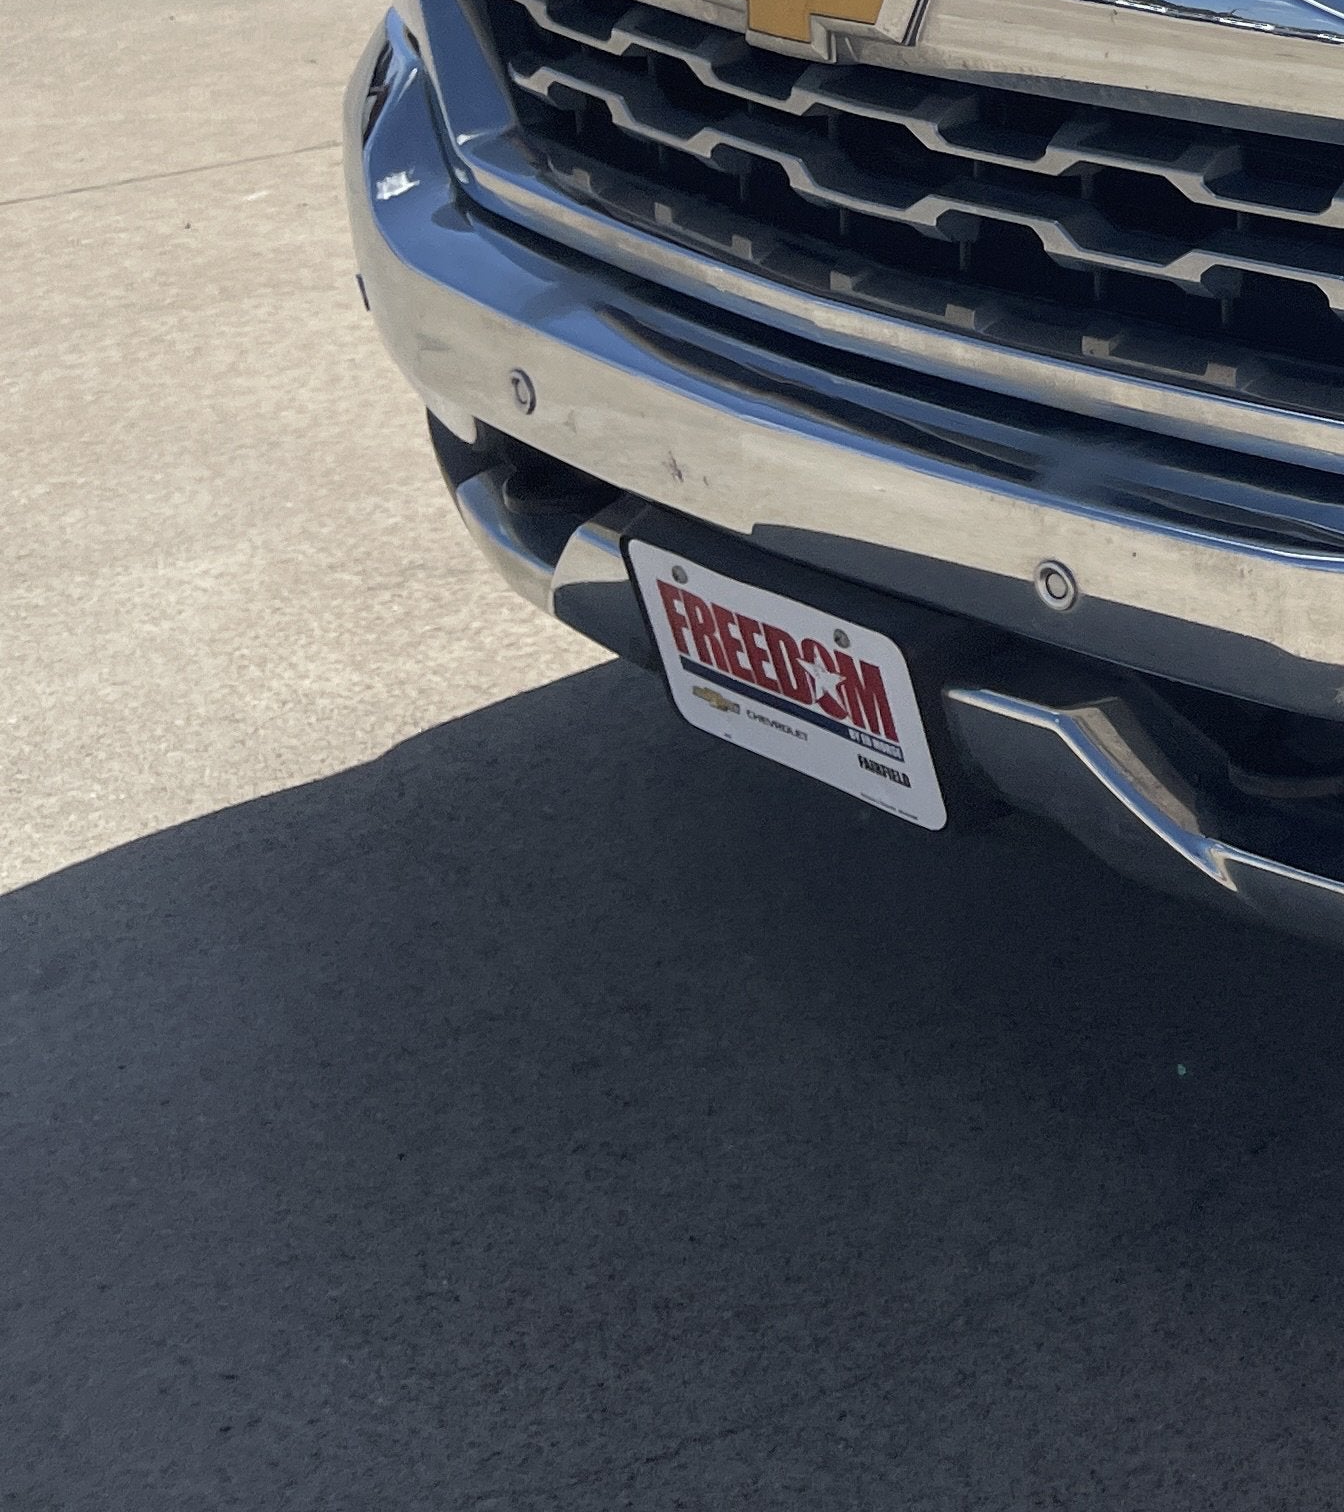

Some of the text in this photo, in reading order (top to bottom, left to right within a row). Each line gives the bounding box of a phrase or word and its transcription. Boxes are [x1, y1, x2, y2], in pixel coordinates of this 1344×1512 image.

[656, 578, 899, 744] FREEDOM
[746, 709, 808, 742] CHEVROLET
[856, 753, 912, 789] FAIRFIELD
